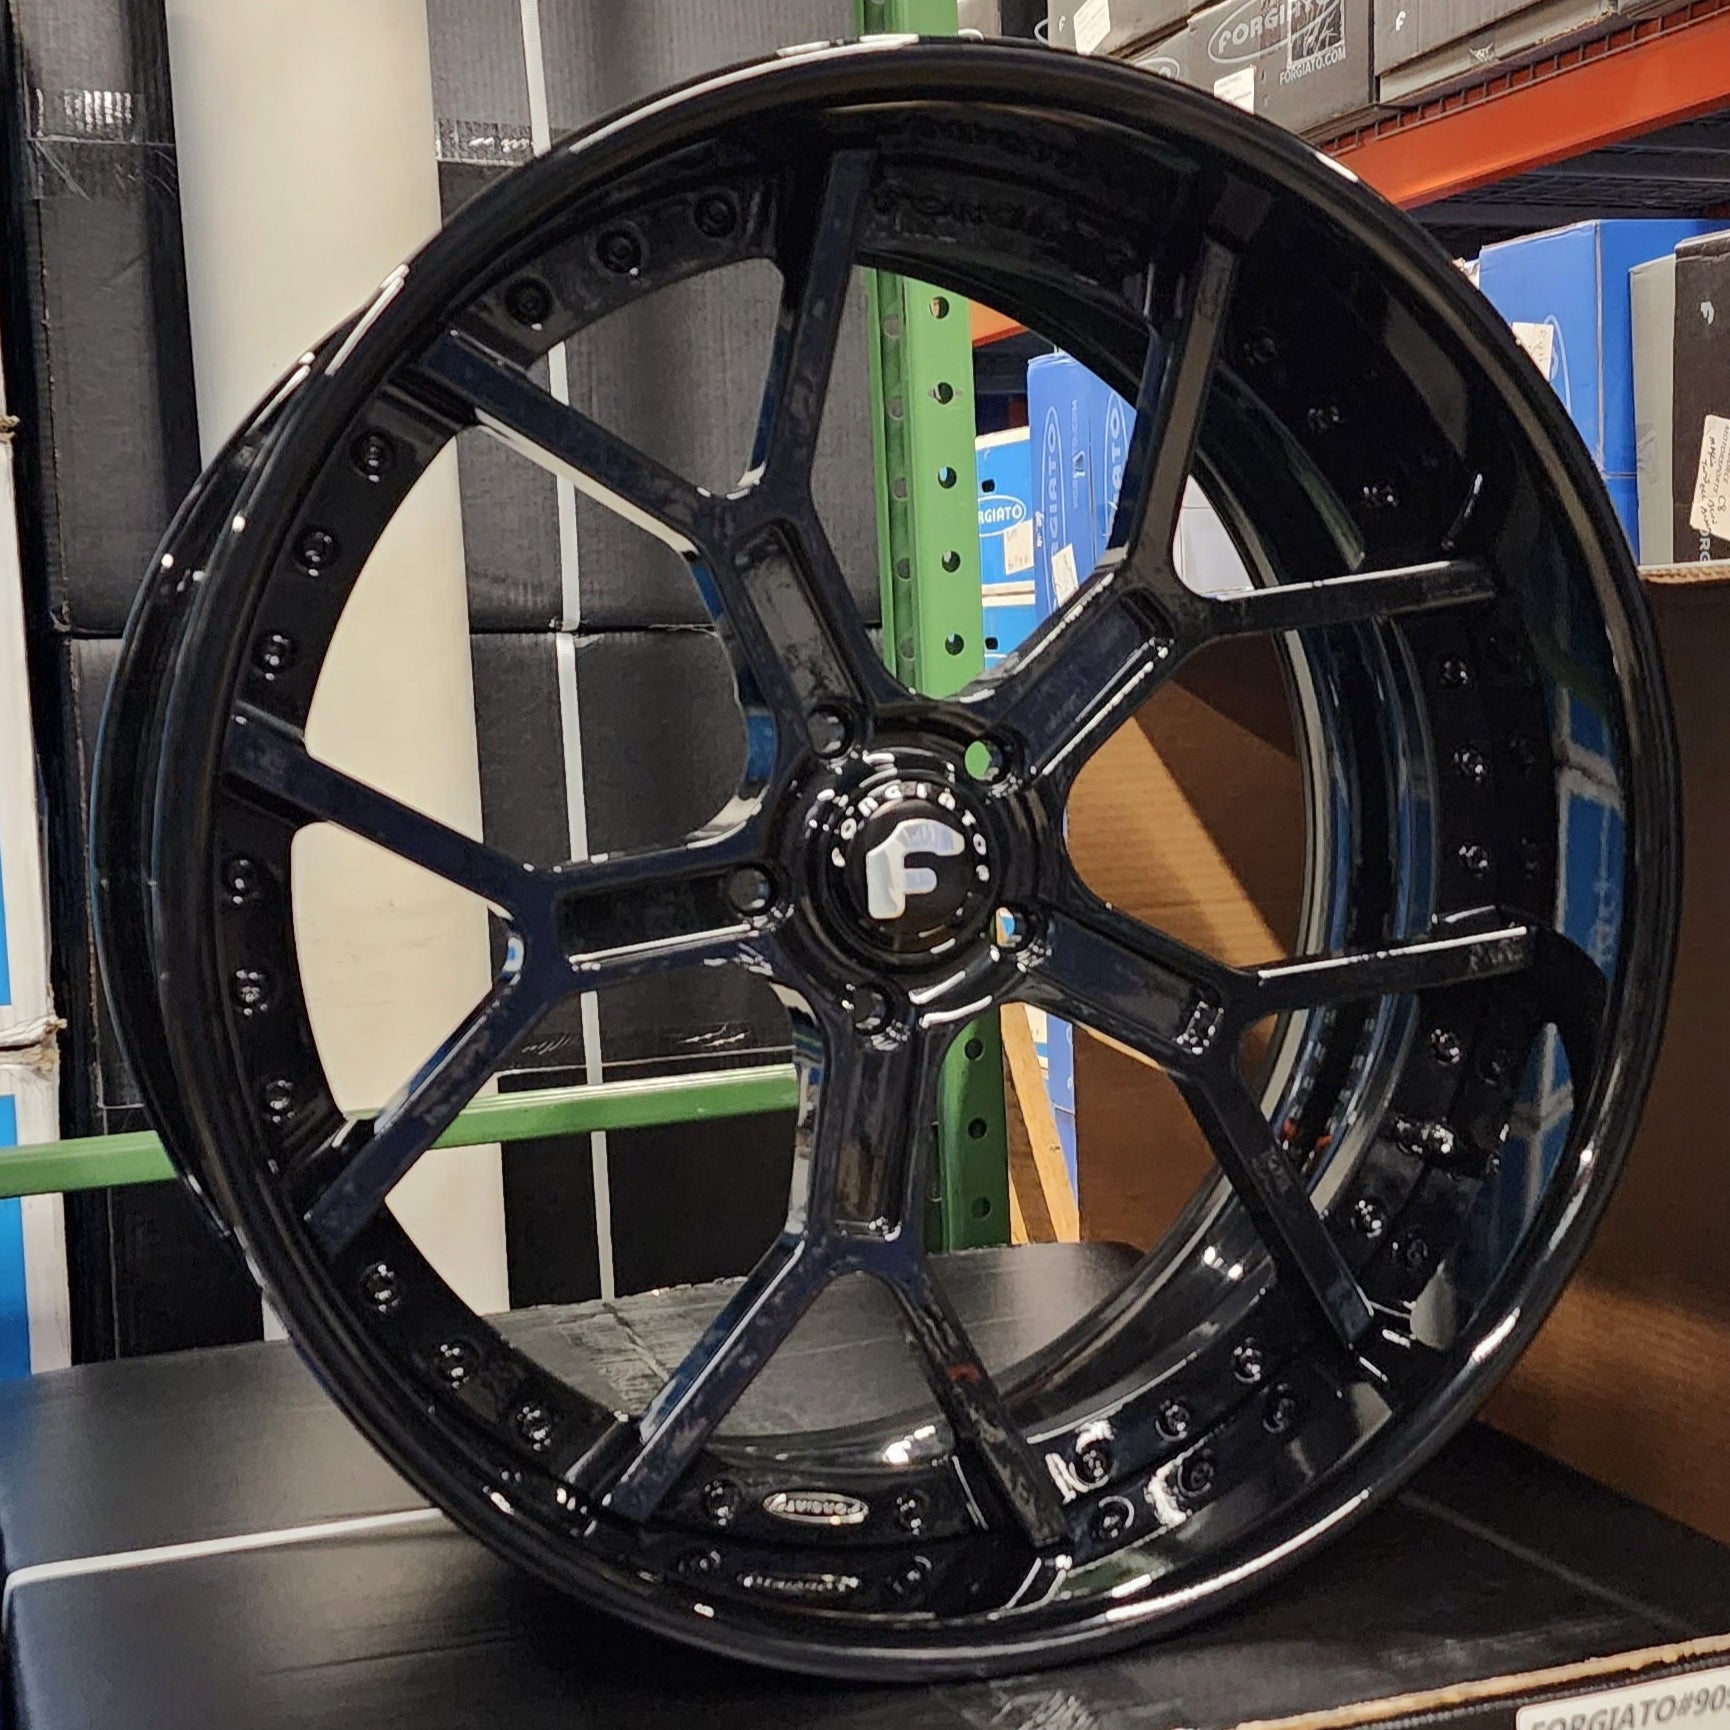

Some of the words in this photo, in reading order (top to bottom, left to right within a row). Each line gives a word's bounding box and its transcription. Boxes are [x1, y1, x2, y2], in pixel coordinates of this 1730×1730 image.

[1279, 46, 1347, 85] FORGIATO.COM
[978, 503, 1023, 525] RGIATO
[865, 817, 966, 920] F
